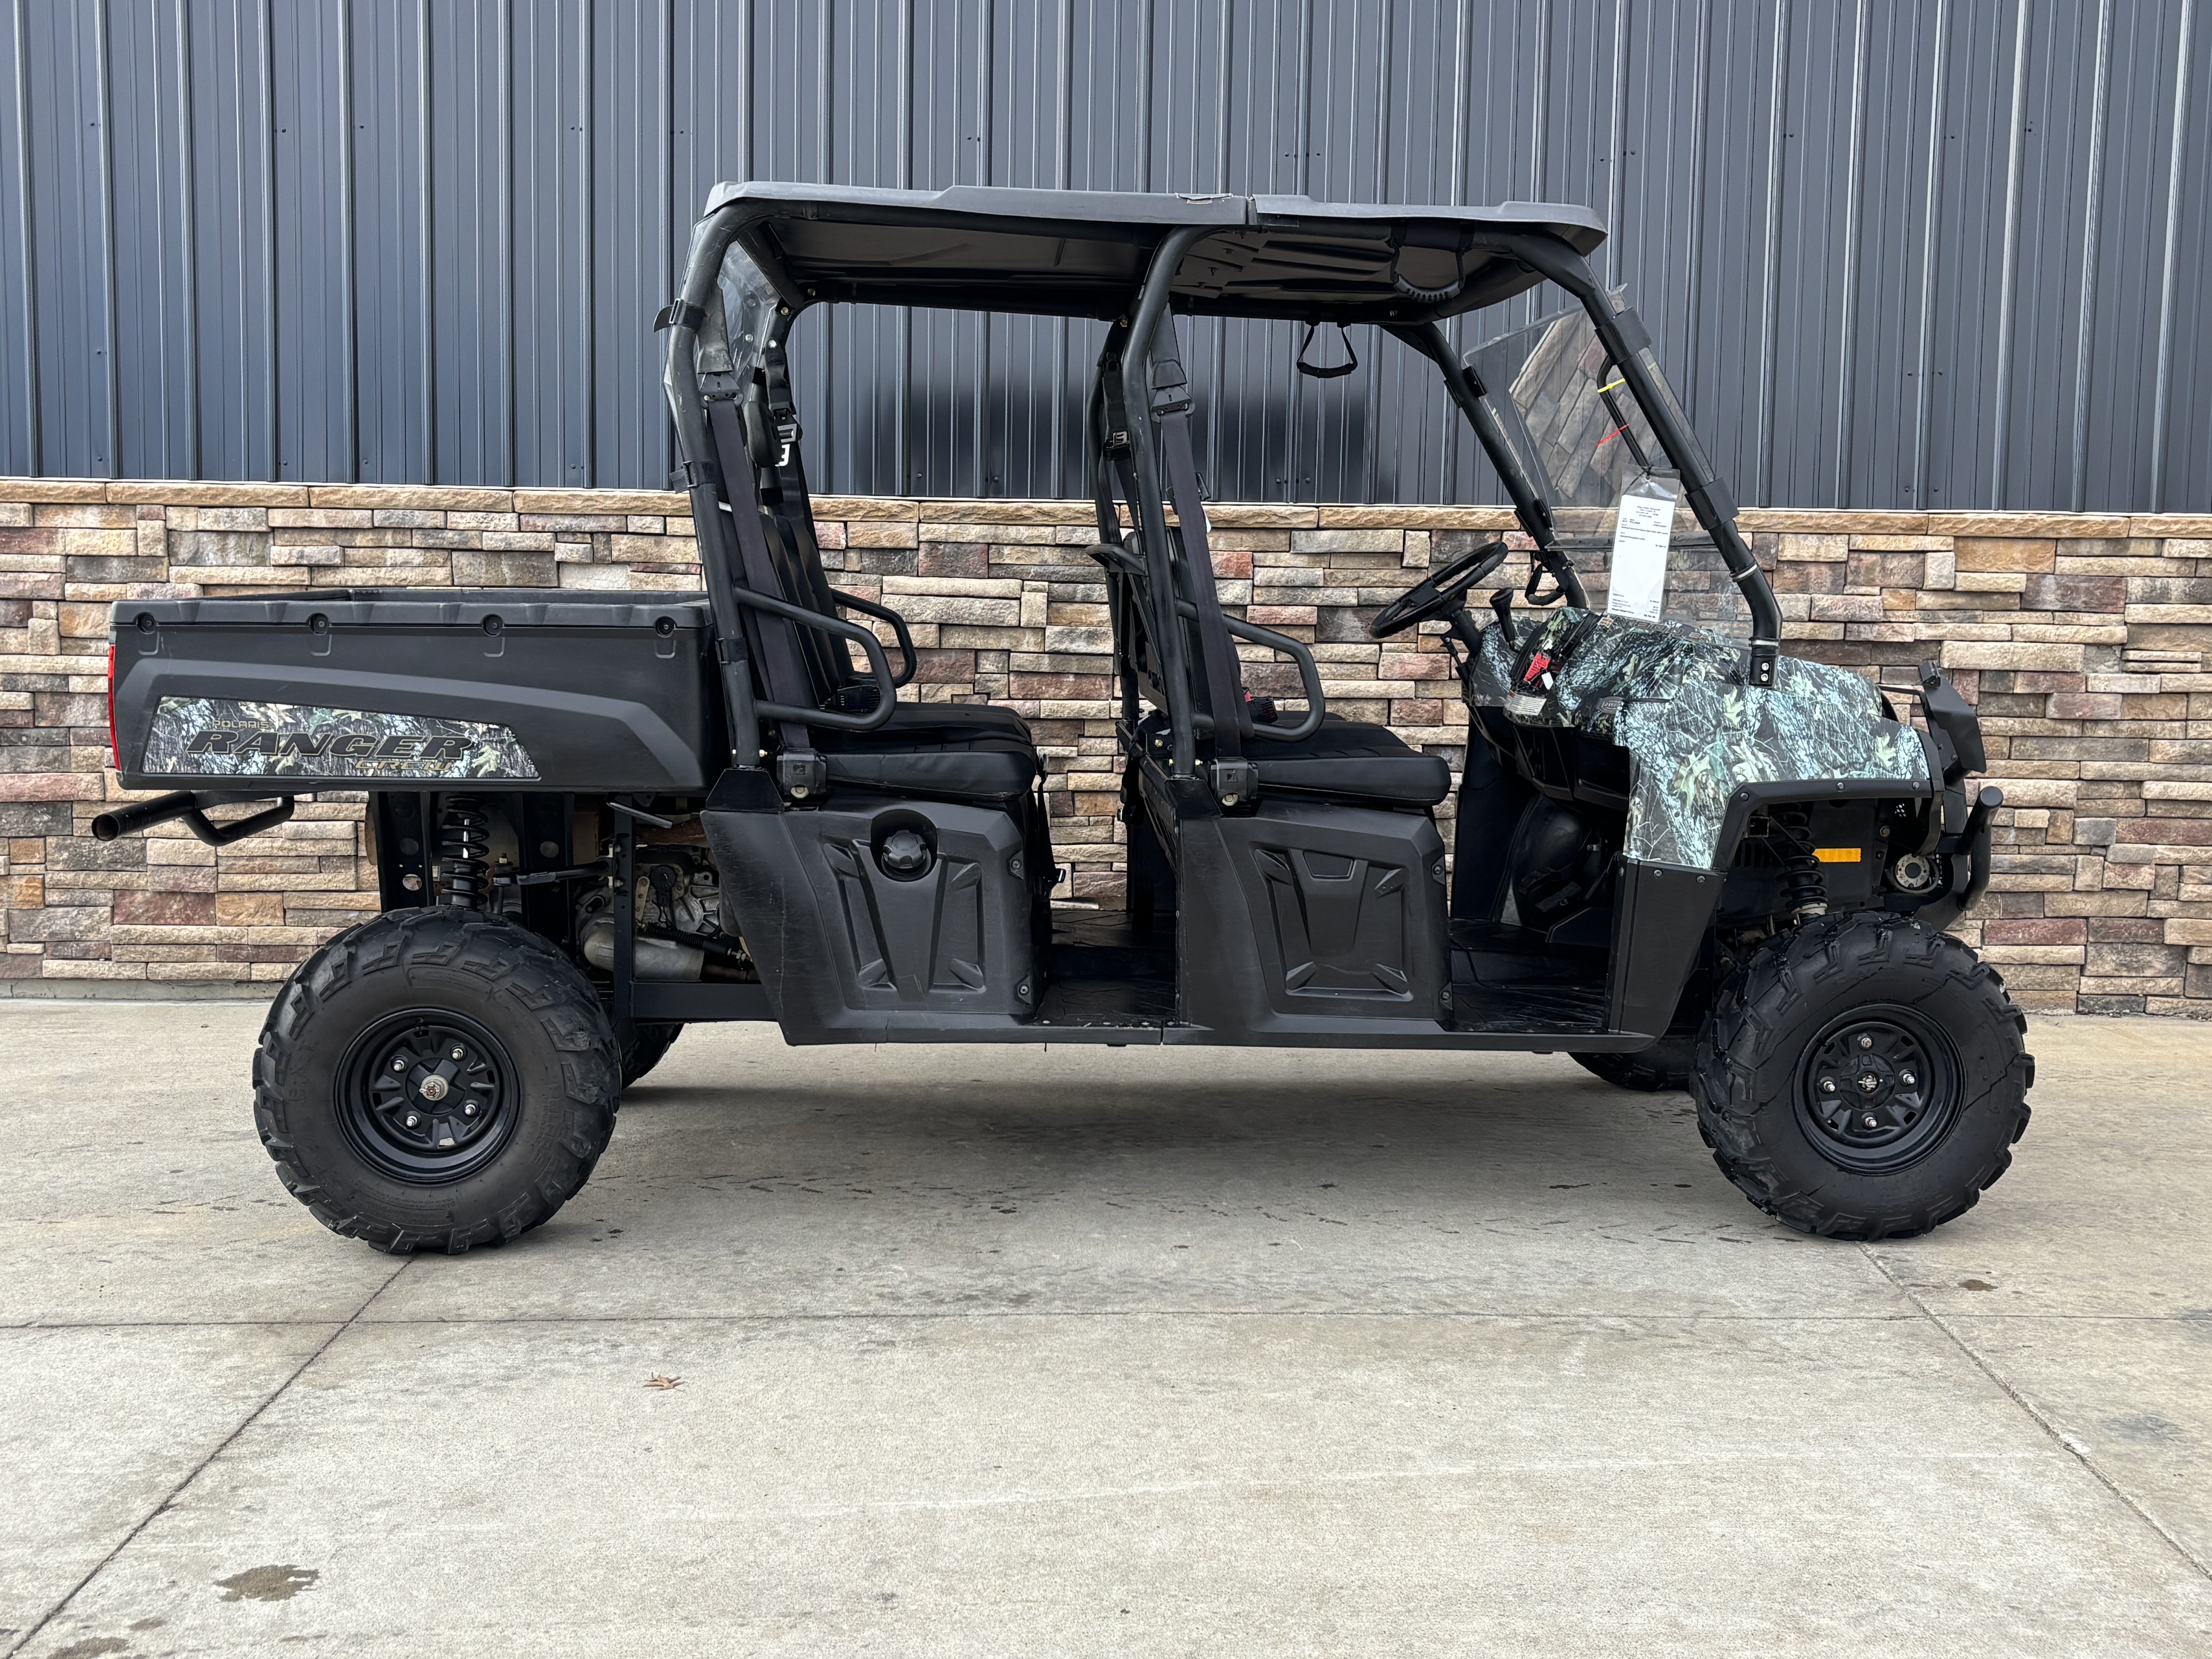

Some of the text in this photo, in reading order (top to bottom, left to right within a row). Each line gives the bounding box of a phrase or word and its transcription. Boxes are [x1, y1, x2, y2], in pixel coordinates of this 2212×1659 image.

[212, 720, 270, 729] POLARIS
[185, 730, 474, 760] RANGER
[355, 760, 453, 771] CREW
